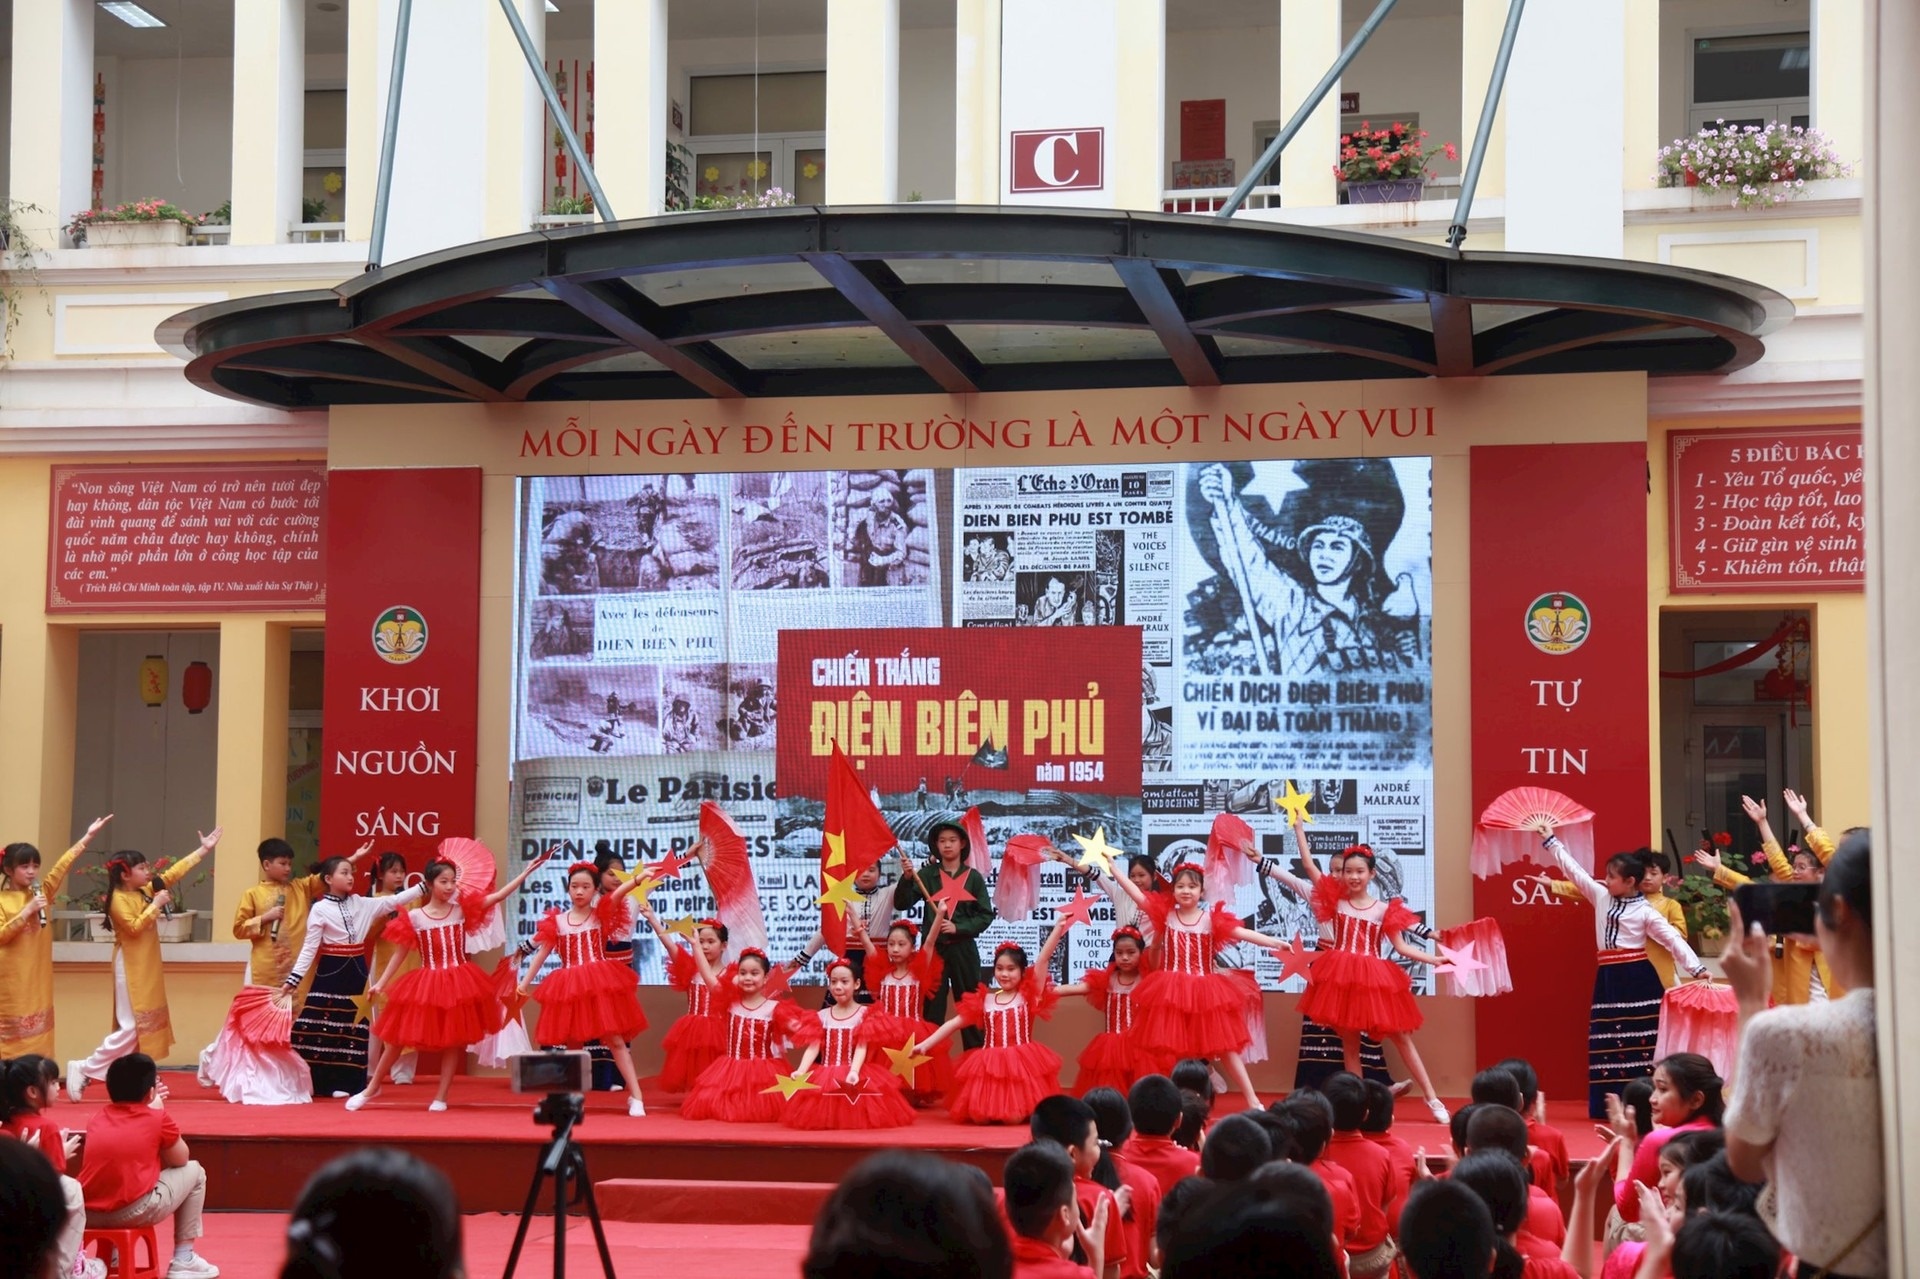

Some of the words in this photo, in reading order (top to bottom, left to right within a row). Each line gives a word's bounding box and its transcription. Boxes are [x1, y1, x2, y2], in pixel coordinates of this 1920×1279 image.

[1034, 132, 1079, 185] C
[519, 416, 599, 458] MỖI
[613, 419, 729, 456] NGÀY
[743, 411, 833, 455] ĐẾN
[848, 413, 1031, 452] TRƯỜNG
[1047, 411, 1094, 448] LÀ
[1111, 407, 1209, 450] MỘT
[1222, 402, 1347, 443] NGÀY
[1358, 407, 1437, 438] VUI
[1731, 449, 1740, 462] 5
[1747, 441, 1799, 462] ĐIỀU
[1806, 442, 1849, 460] BÁC
[1128, 481, 1140, 489] 10
[1696, 473, 1703, 488] 1
[1724, 472, 1754, 487] Yêu
[1761, 467, 1786, 486] Tổ
[1789, 467, 1837, 488] quốc,
[108, 482, 134, 496] sông
[141, 482, 164, 493] Việt
[170, 481, 197, 492] Nam
[203, 481, 216, 493] có
[222, 481, 240, 493] trở
[245, 482, 266, 492] nên
[272, 480, 294, 491] tươi
[301, 479, 321, 493] đẹp
[67, 500, 87, 513] hay
[93, 499, 132, 513] không,
[138, 498, 159, 511] dân
[165, 499, 183, 512] tộc
[189, 498, 212, 512] Việt
[219, 498, 246, 509] Nam
[252, 497, 265, 510] có
[271, 497, 298, 509] bước
[304, 497, 319, 508] tới
[1695, 495, 1704, 509] 2
[1722, 494, 1759, 511] Học
[1765, 493, 1792, 511] tập
[1798, 488, 1827, 507] tốt,
[1834, 492, 1862, 505] lao
[66, 516, 84, 528] đài
[91, 516, 115, 528] vinh
[121, 518, 156, 530] quang
[162, 513, 177, 527] để
[180, 516, 207, 527] sánh
[215, 516, 230, 527] vai
[237, 515, 254, 526] với
[260, 515, 279, 526] các
[285, 514, 319, 528] cường
[964, 514, 999, 527] DIEN
[1007, 514, 1041, 526] BIEN
[1050, 513, 1081, 526] PHU
[1088, 513, 1112, 524] EST
[1120, 507, 1173, 524] TOMBÉ
[1695, 517, 1704, 531] 3
[1723, 515, 1772, 530] Đoàn
[1778, 512, 1806, 530] kết
[1812, 511, 1841, 529] tốt,
[65, 531, 95, 548] quốc
[101, 535, 127, 546] năm
[134, 533, 164, 545] châu
[170, 532, 200, 546] được
[206, 532, 228, 547] hay
[235, 531, 277, 545] không,
[283, 530, 318, 542] chính
[1133, 542, 1167, 550] VOICES
[1696, 540, 1706, 552] 4
[1723, 538, 1757, 553] Giữ
[1761, 540, 1789, 555] gìn
[1796, 537, 1814, 553] vệ
[1819, 536, 1856, 550] sinh
[65, 551, 75, 563] là
[82, 550, 104, 562] nhờ
[111, 550, 132, 563] một
[138, 547, 168, 564] phần
[175, 549, 193, 562] lớn
[199, 549, 207, 562] ở
[212, 549, 239, 563] công
[246, 549, 266, 563] học
[272, 547, 291, 562] tập
[297, 547, 318, 560] của
[1696, 562, 1706, 575] 5
[1724, 560, 1782, 575] Khiêm
[1789, 555, 1822, 575] tốn,
[1829, 558, 1865, 575] thật
[64, 569, 84, 580] các
[1129, 562, 1170, 572] SILENCE
[123, 583, 138, 592] Chí
[140, 582, 160, 591] Minh
[162, 582, 180, 592] toàn
[199, 582, 211, 594] tập
[227, 582, 243, 591] Nhà
[245, 581, 263, 591] xuất
[265, 581, 279, 590] bản
[281, 582, 292, 592] Sự
[295, 581, 313, 592] Thật
[601, 610, 627, 619] Avec
[634, 608, 648, 618] les
[655, 606, 719, 618] défenseurs
[1136, 612, 1162, 622] ANDRÉ
[598, 639, 633, 650] DIEN
[643, 638, 676, 649] BIEN
[687, 637, 718, 648] PHU
[812, 651, 870, 686] CHIẾN
[875, 648, 940, 686] THẮNG
[360, 686, 440, 712] KHƠI
[1240, 682, 1281, 706] DỊCH
[1530, 678, 1582, 712] TỰ
[810, 690, 901, 770] ĐIỆN
[916, 689, 1008, 755] BIÊN
[1023, 681, 1104, 755] PHỦ
[335, 741, 456, 775] NGUỒN
[1521, 748, 1588, 775] TIN
[1036, 762, 1064, 782] năm
[1068, 761, 1104, 781] 1954
[606, 779, 648, 804] Le
[1374, 780, 1410, 792] ANDRÉ
[1364, 796, 1420, 806] MALRAUX
[356, 806, 440, 836] SÁNG
[521, 879, 554, 893] Les
[767, 877, 782, 885] mai
[1077, 939, 1111, 948] VOICES
